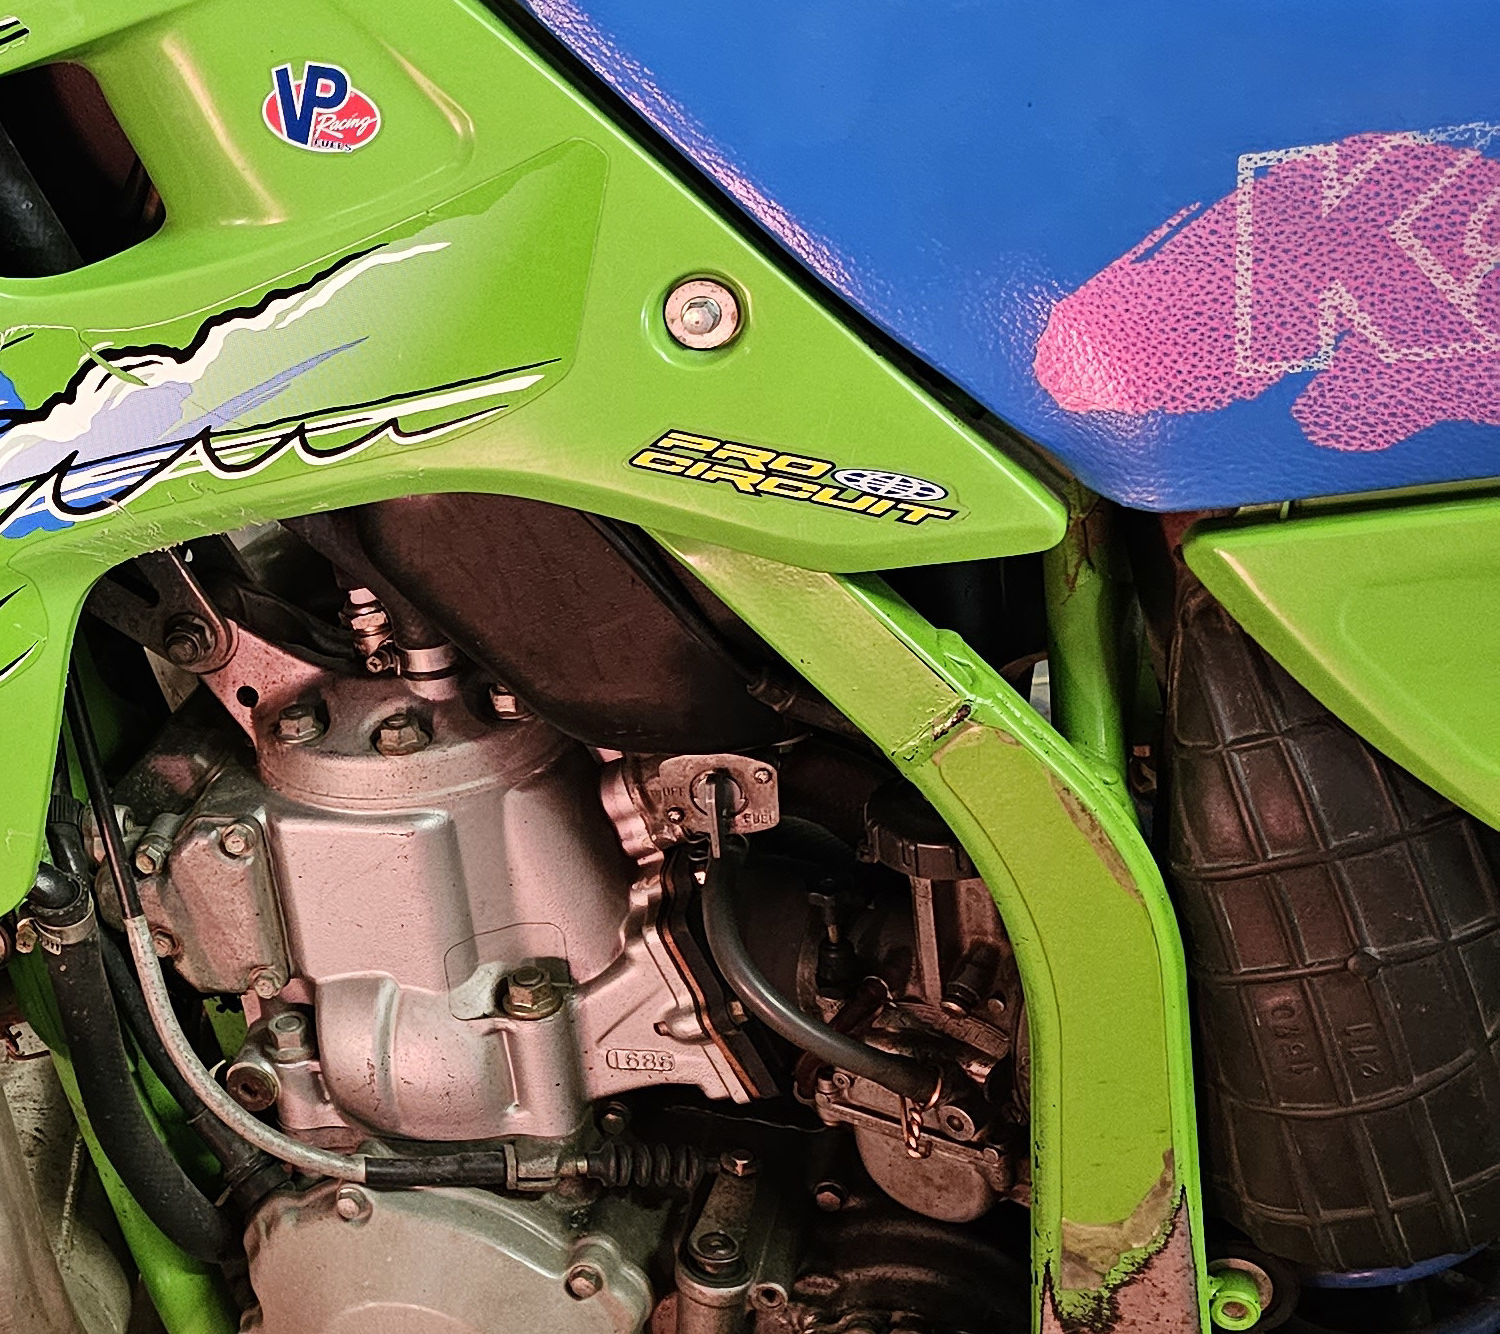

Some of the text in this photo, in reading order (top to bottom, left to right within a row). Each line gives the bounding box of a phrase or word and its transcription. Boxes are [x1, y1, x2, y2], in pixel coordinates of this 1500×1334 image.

[273, 63, 349, 146] VP
[314, 113, 378, 139] Racing
[650, 428, 836, 480] PRO
[629, 449, 959, 525] CIRCUIT
[743, 812, 775, 825] FUEL
[614, 1050, 674, 1070] 1686
